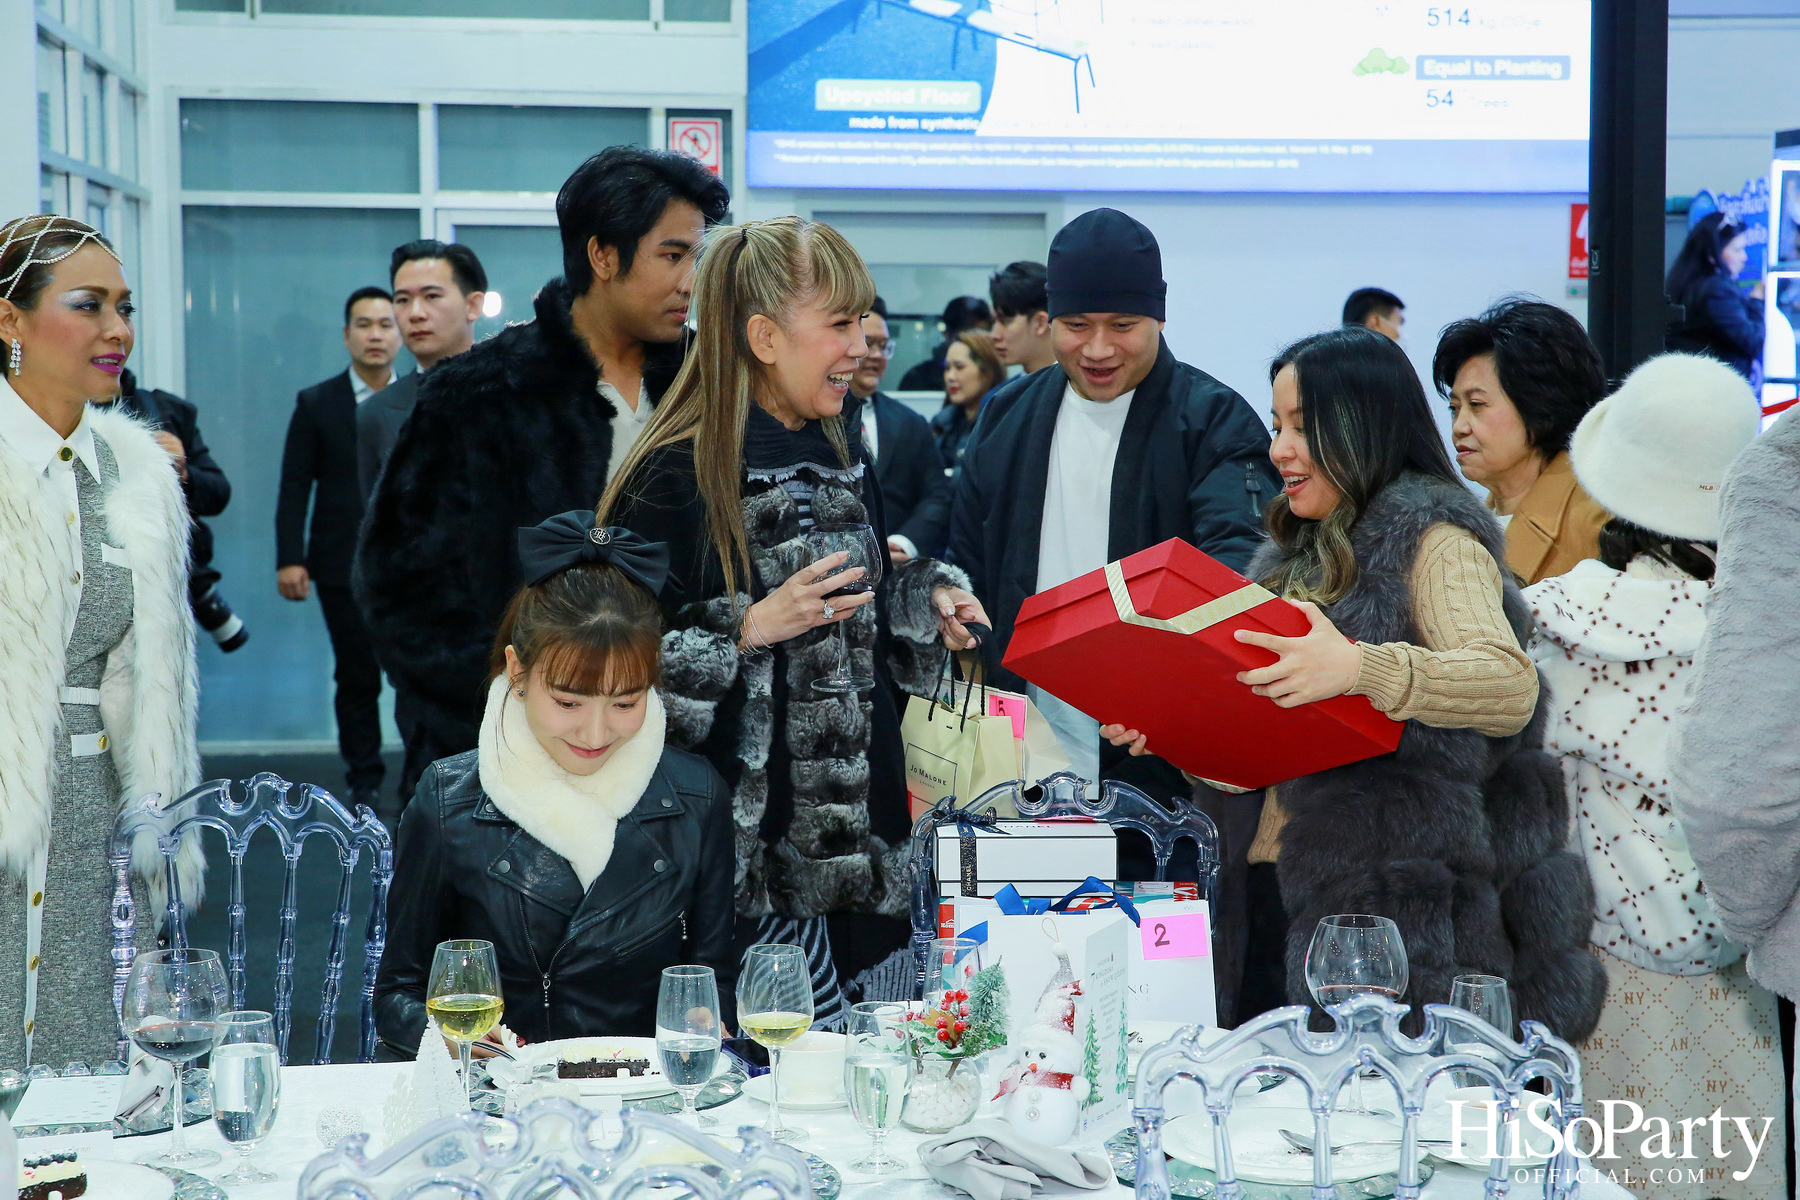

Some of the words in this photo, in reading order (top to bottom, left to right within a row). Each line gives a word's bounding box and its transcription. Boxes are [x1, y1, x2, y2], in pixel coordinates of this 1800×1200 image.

[1427, 7, 1471, 27] 514
[1423, 58, 1471, 79] Equal
[1473, 60, 1492, 76] to
[1494, 58, 1563, 80] Planting
[920, 87, 971, 105] Floor
[1426, 89, 1454, 108] 54
[888, 115, 919, 129] from
[919, 767, 947, 786] MALONE
[1154, 923, 1170, 947] 2
[1624, 992, 1645, 1005] NY
[1709, 988, 1731, 1001] NY
[1626, 1085, 1646, 1098] NY
[1706, 1080, 1728, 1093] NY
